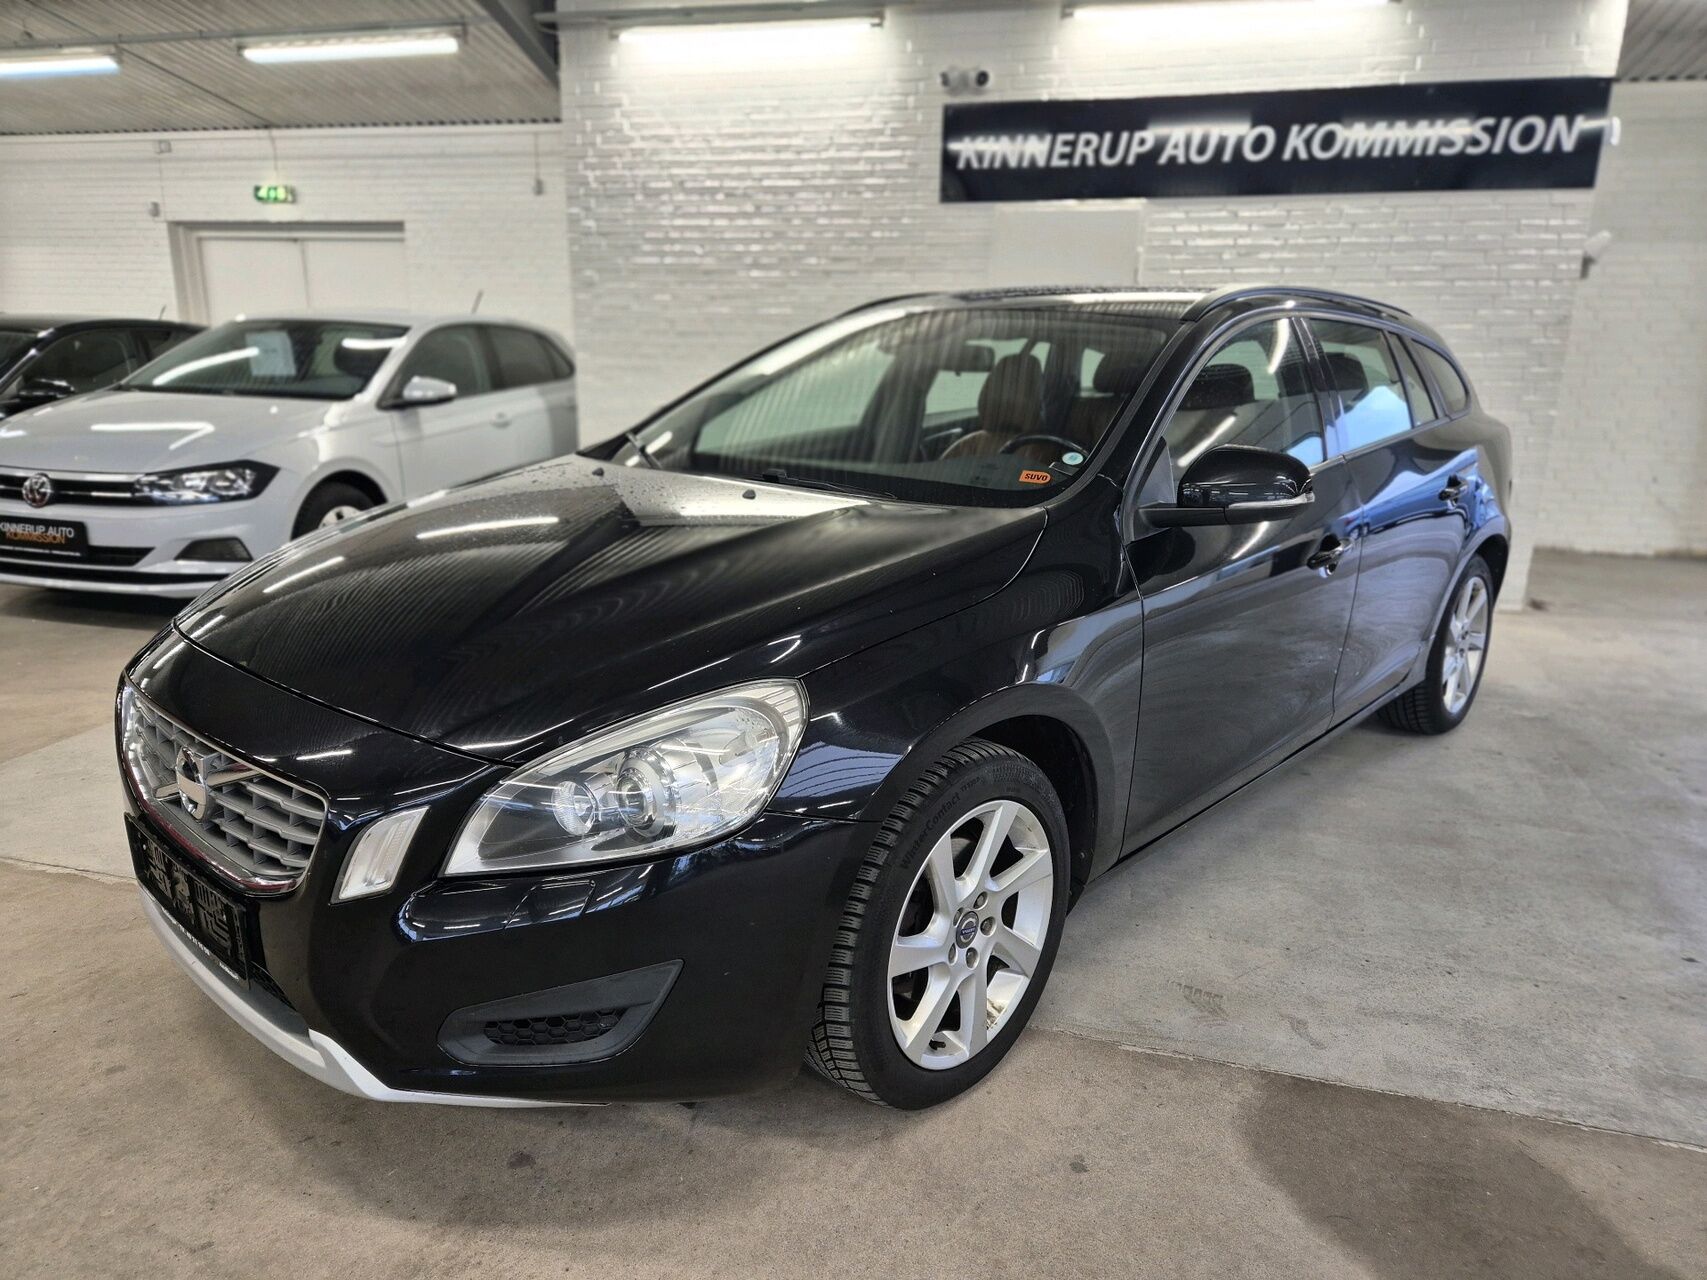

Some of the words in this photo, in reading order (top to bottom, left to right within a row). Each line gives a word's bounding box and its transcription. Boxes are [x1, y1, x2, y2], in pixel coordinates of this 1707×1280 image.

[956, 131, 1156, 170] KINNERUP
[1157, 124, 1277, 165] AUTO
[1281, 114, 1585, 161] KOMMISSION
[1024, 473, 1048, 482] SUVO
[0, 522, 46, 534] KINNERUP
[47, 525, 75, 538] AUTO
